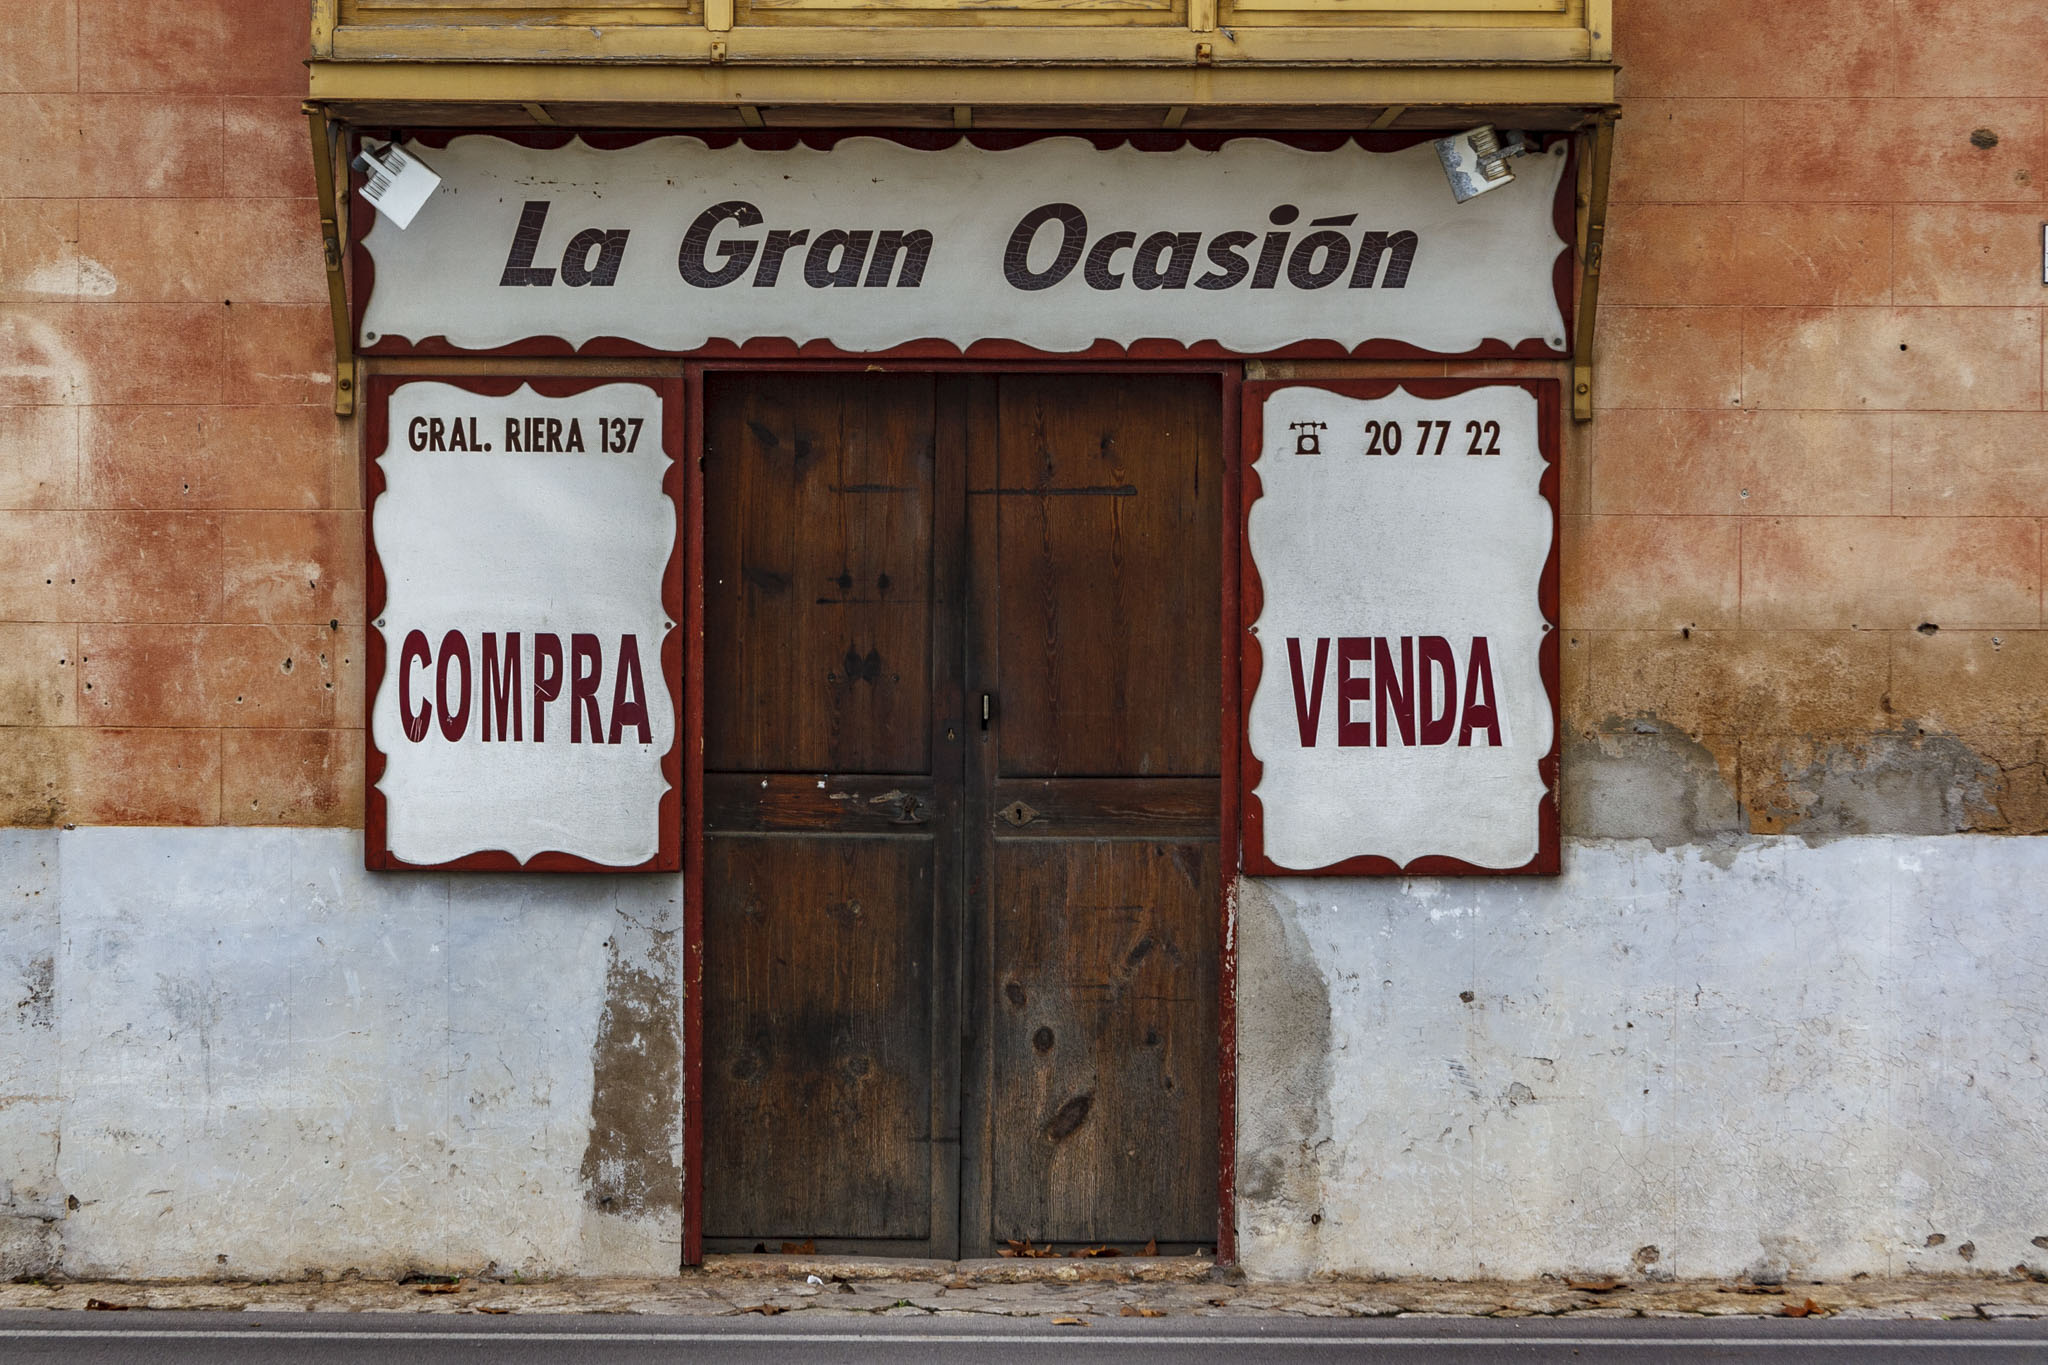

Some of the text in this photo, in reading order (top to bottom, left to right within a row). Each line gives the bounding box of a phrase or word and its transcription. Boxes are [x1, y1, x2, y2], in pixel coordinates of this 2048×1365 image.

[499, 201, 1418, 291] La Gran Ocasión
[408, 416, 645, 454] GRAL. RIERA 137
[1364, 420, 1501, 456] 20 77 22
[399, 629, 653, 745] COMPRA
[1287, 636, 1503, 748] VENDA
